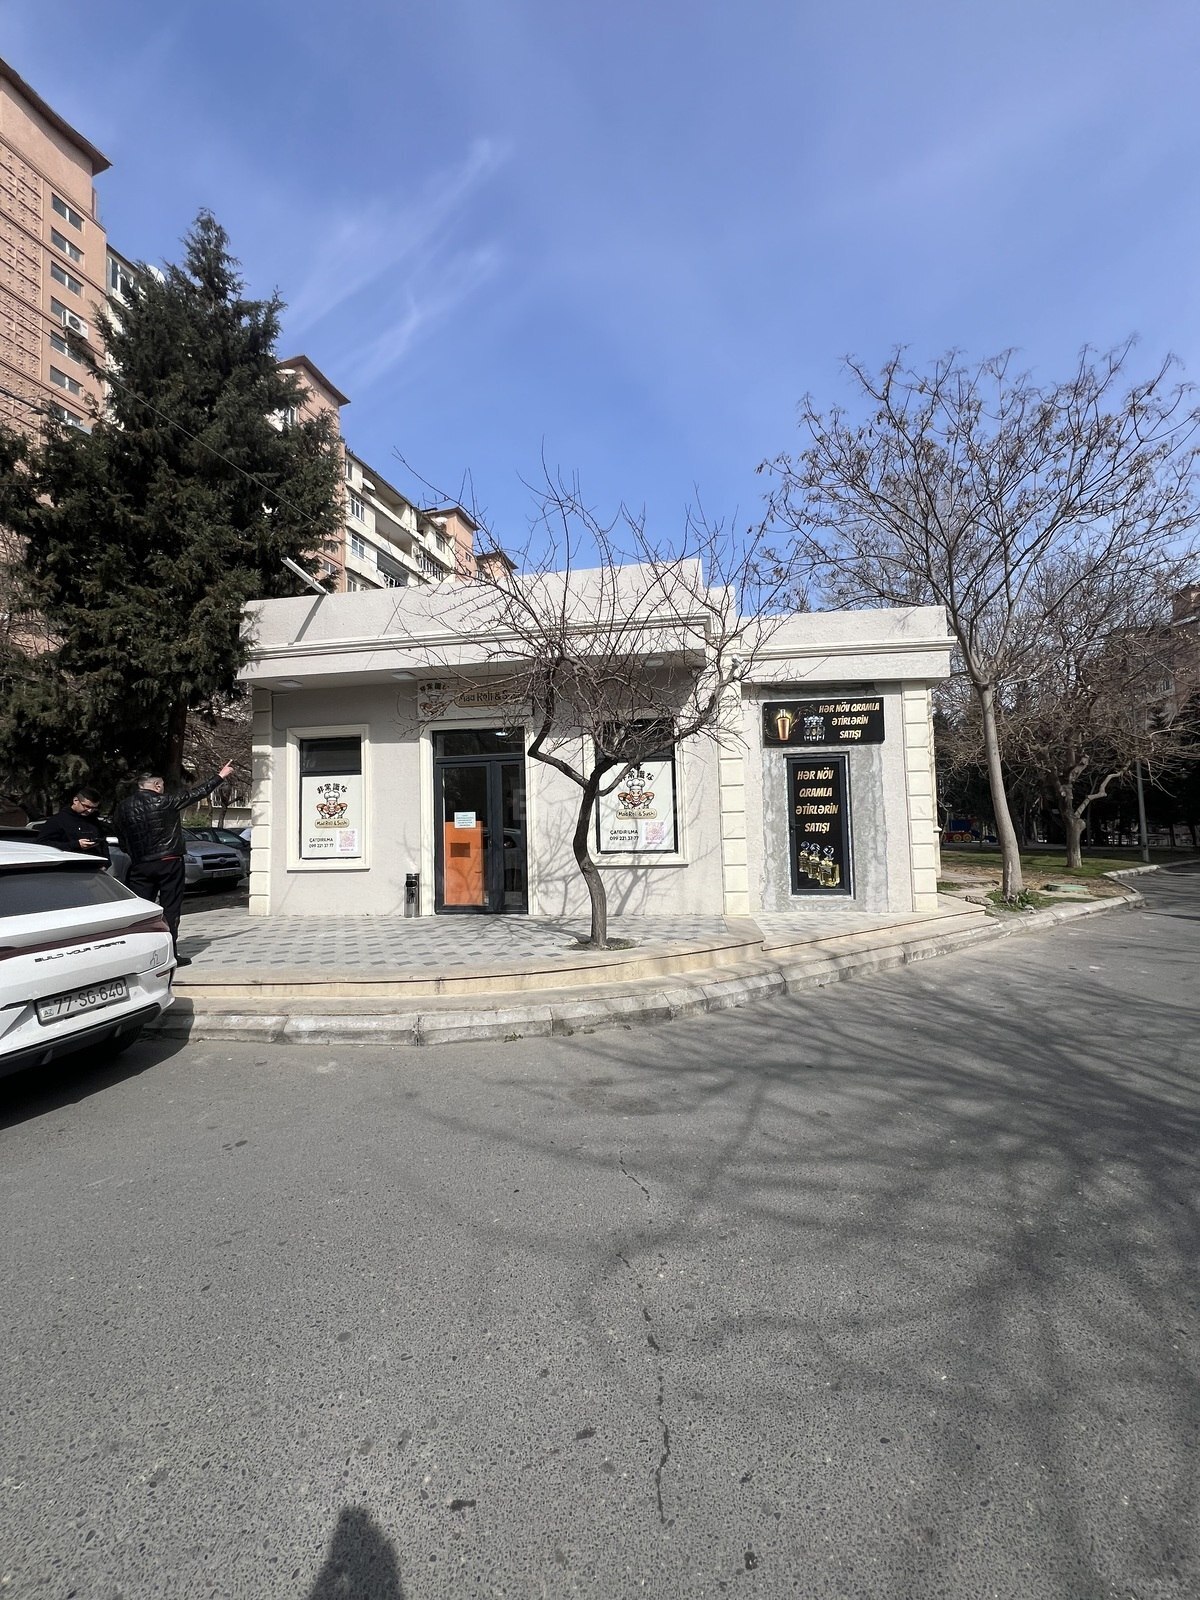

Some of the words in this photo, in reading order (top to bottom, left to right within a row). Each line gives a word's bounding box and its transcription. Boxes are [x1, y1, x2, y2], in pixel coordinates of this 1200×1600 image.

[819, 705, 835, 714] HƏR
[835, 701, 850, 713] NÖV
[851, 702, 880, 712] QRAMLA
[831, 714, 869, 726] ƏTİRLƏRİN
[839, 729, 862, 740] SATIŞI
[797, 770, 816, 780] HƏR
[816, 767, 834, 780] NÖV
[799, 787, 833, 798] QRAMLA
[795, 802, 839, 815] ƏTİRLƏRİN
[804, 822, 831, 834] SATIŞI
[34, 953, 64, 963] BUILD
[66, 947, 92, 956] YOUR
[93, 940, 127, 950] DREAMS
